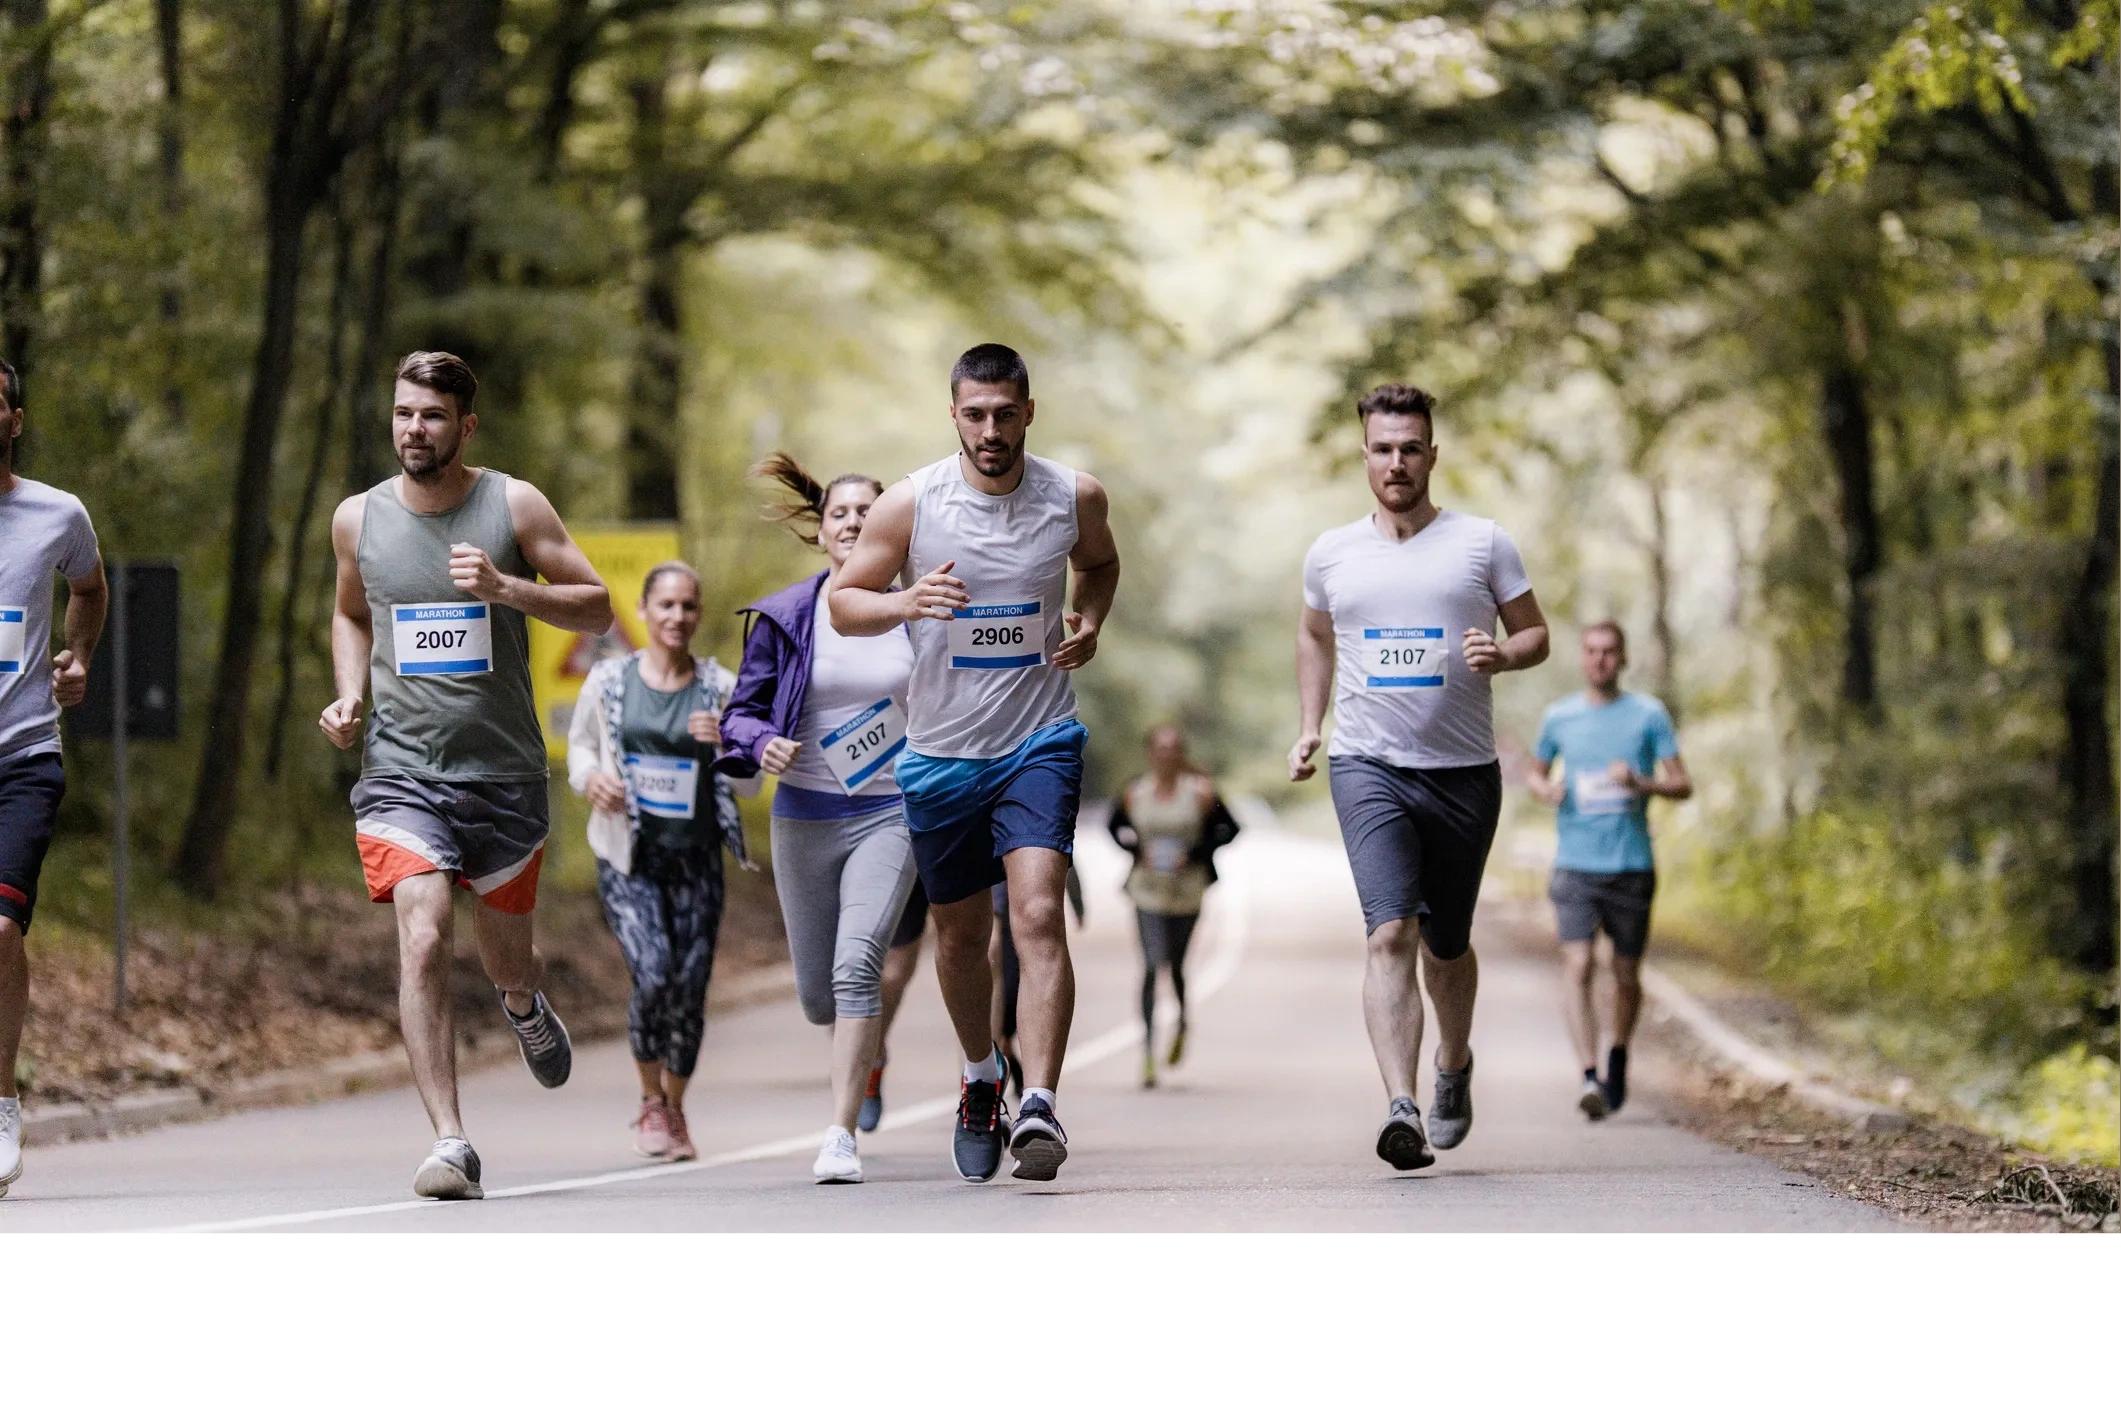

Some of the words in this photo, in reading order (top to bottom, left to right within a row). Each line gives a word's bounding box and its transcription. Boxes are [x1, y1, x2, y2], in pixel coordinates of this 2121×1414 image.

[415, 609, 465, 619] MARATHON
[972, 607, 1023, 616] MARATHON
[416, 630, 467, 649] 2007
[972, 626, 1024, 645] 2906
[1380, 629, 1425, 638] MARATHON
[1380, 648, 1426, 665] 2107
[836, 708, 876, 738] MARATHON
[846, 722, 886, 760] 2107
